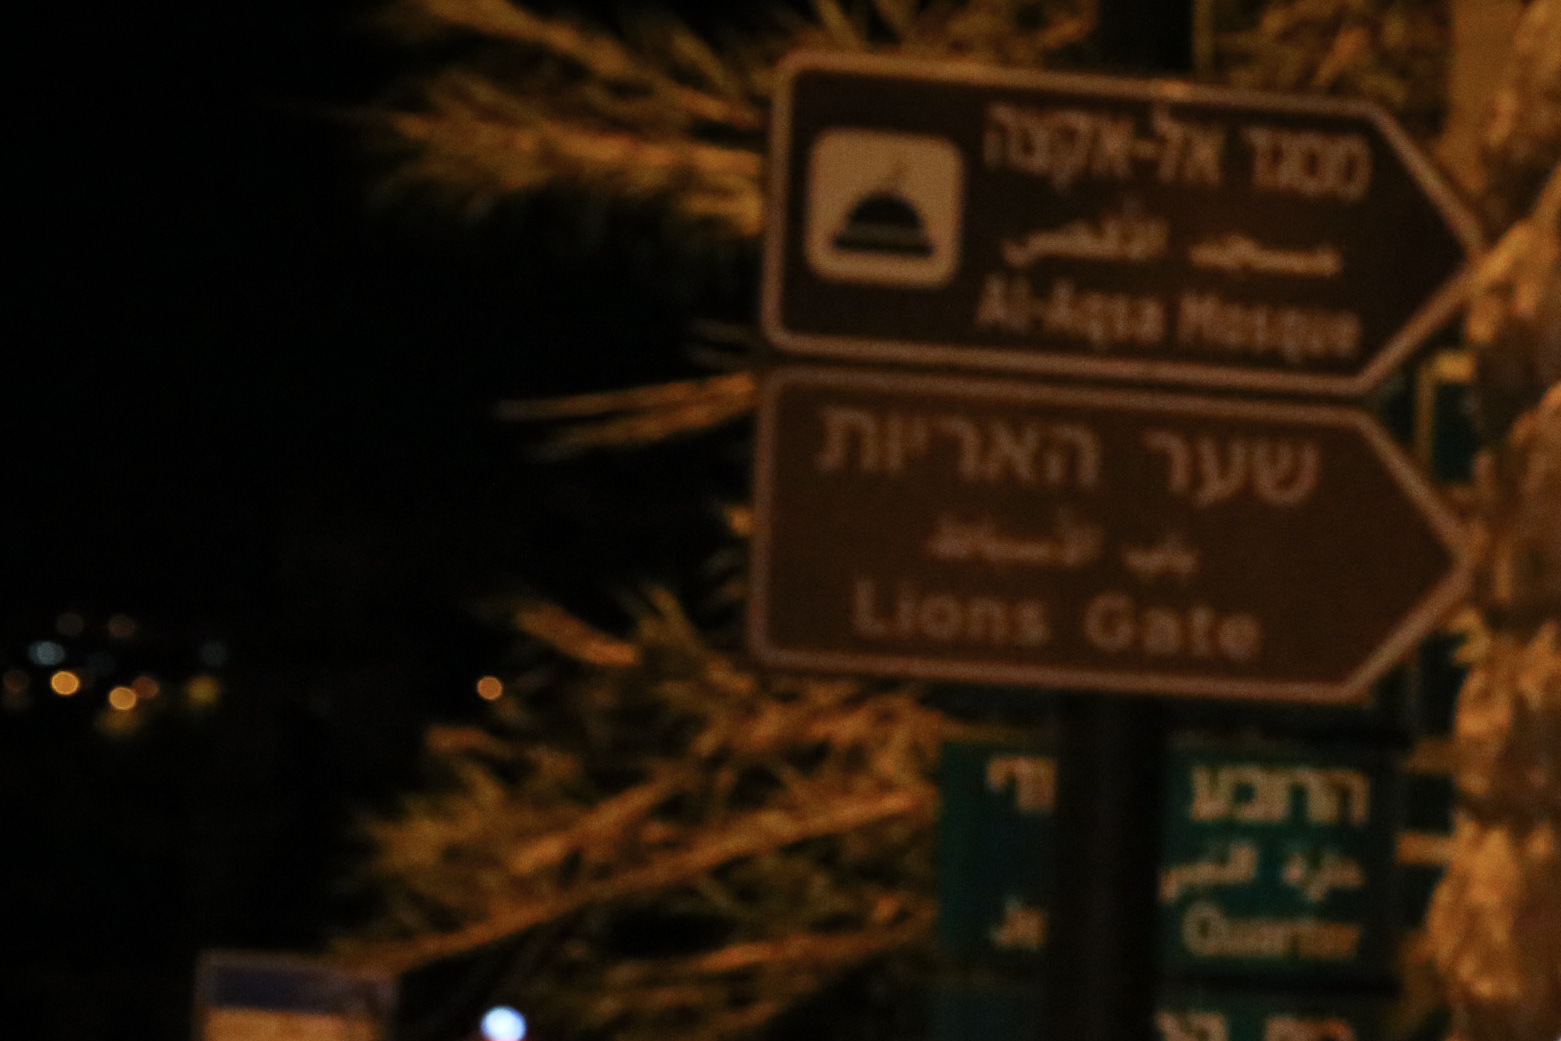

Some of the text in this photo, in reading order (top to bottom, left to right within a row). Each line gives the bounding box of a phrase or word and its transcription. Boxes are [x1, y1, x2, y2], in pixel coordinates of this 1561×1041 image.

[1243, 127, 1374, 202] מסגד
[974, 272, 1364, 364] Al-Aqsa Mosque
[815, 404, 1322, 508] שער האריות
[853, 578, 1264, 663] Lions Gate
[1181, 902, 1363, 961] Quarter
